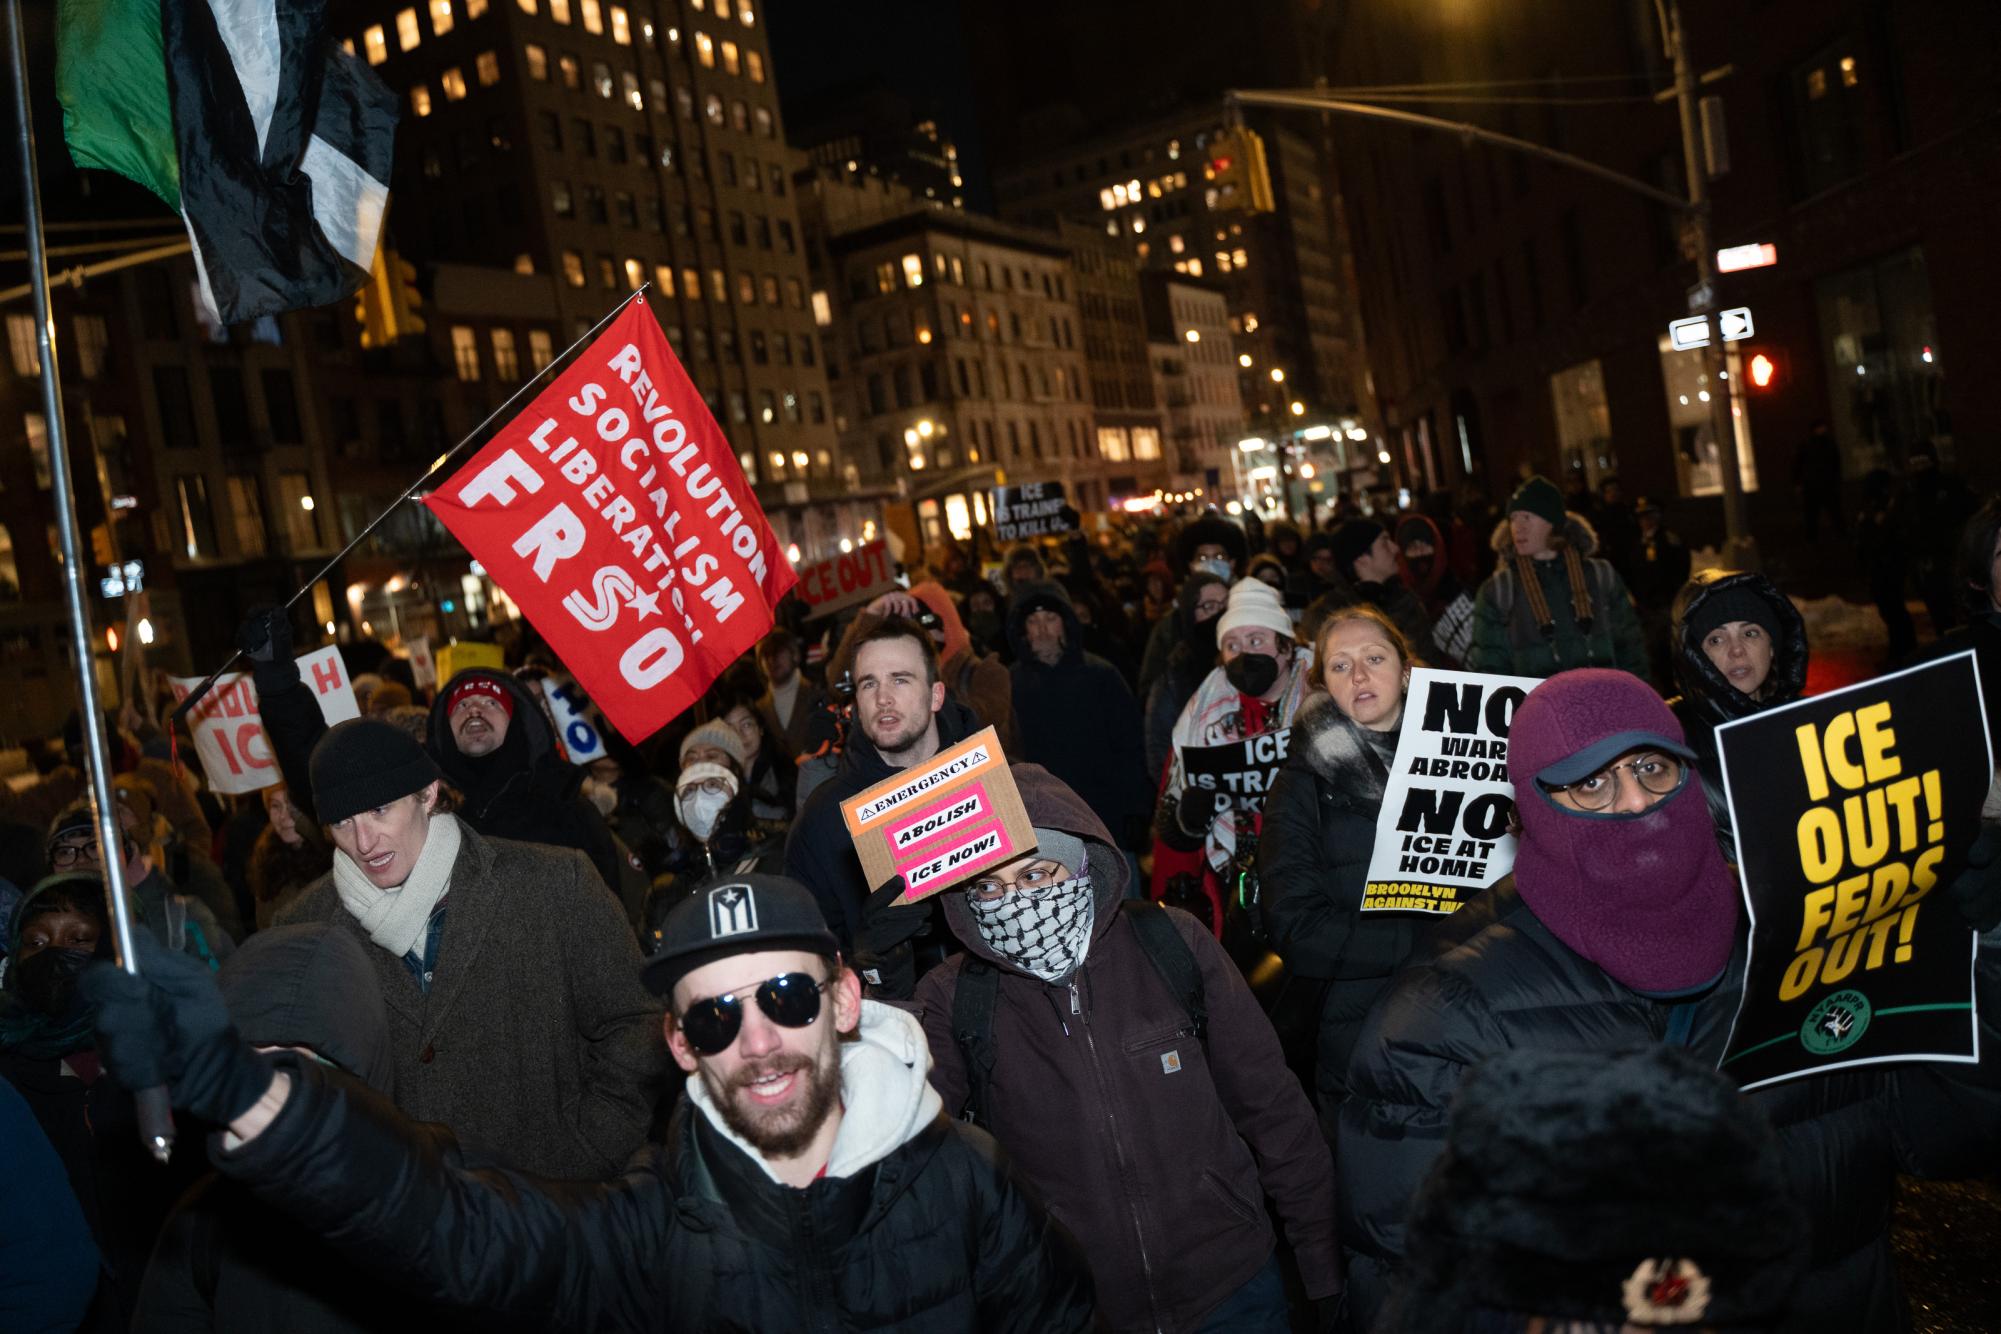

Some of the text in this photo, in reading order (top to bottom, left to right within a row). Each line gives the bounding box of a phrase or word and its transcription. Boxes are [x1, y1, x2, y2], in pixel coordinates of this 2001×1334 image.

[607, 343, 767, 587] REVOLUTION
[569, 383, 745, 623] SOCIALISM
[1011, 497, 1066, 520] TRAINE
[458, 448, 684, 690] FRSO
[838, 541, 888, 592] OUT
[1421, 681, 1528, 739] NO
[212, 724, 273, 775] IC
[1244, 729, 1291, 765] ICE
[1407, 756, 1508, 783] ABROA
[1441, 737, 1508, 760] WAR
[1795, 700, 1902, 801] ICE
[874, 758, 969, 813] EMERGENCY
[1187, 772, 1217, 790] IS
[899, 799, 977, 844] ABOLISH
[1396, 787, 1516, 840] NO
[1796, 769, 1944, 884] OUT!
[911, 835, 995, 884] ICE NOW!
[1399, 855, 1488, 880] HOME
[1401, 834, 1496, 860] ICE AT
[1363, 896, 1438, 911] AGAINST
[1365, 883, 1457, 899] BROOKLYN
[1795, 845, 1945, 952] FEDS
[1778, 903, 1920, 1002] OUT!
